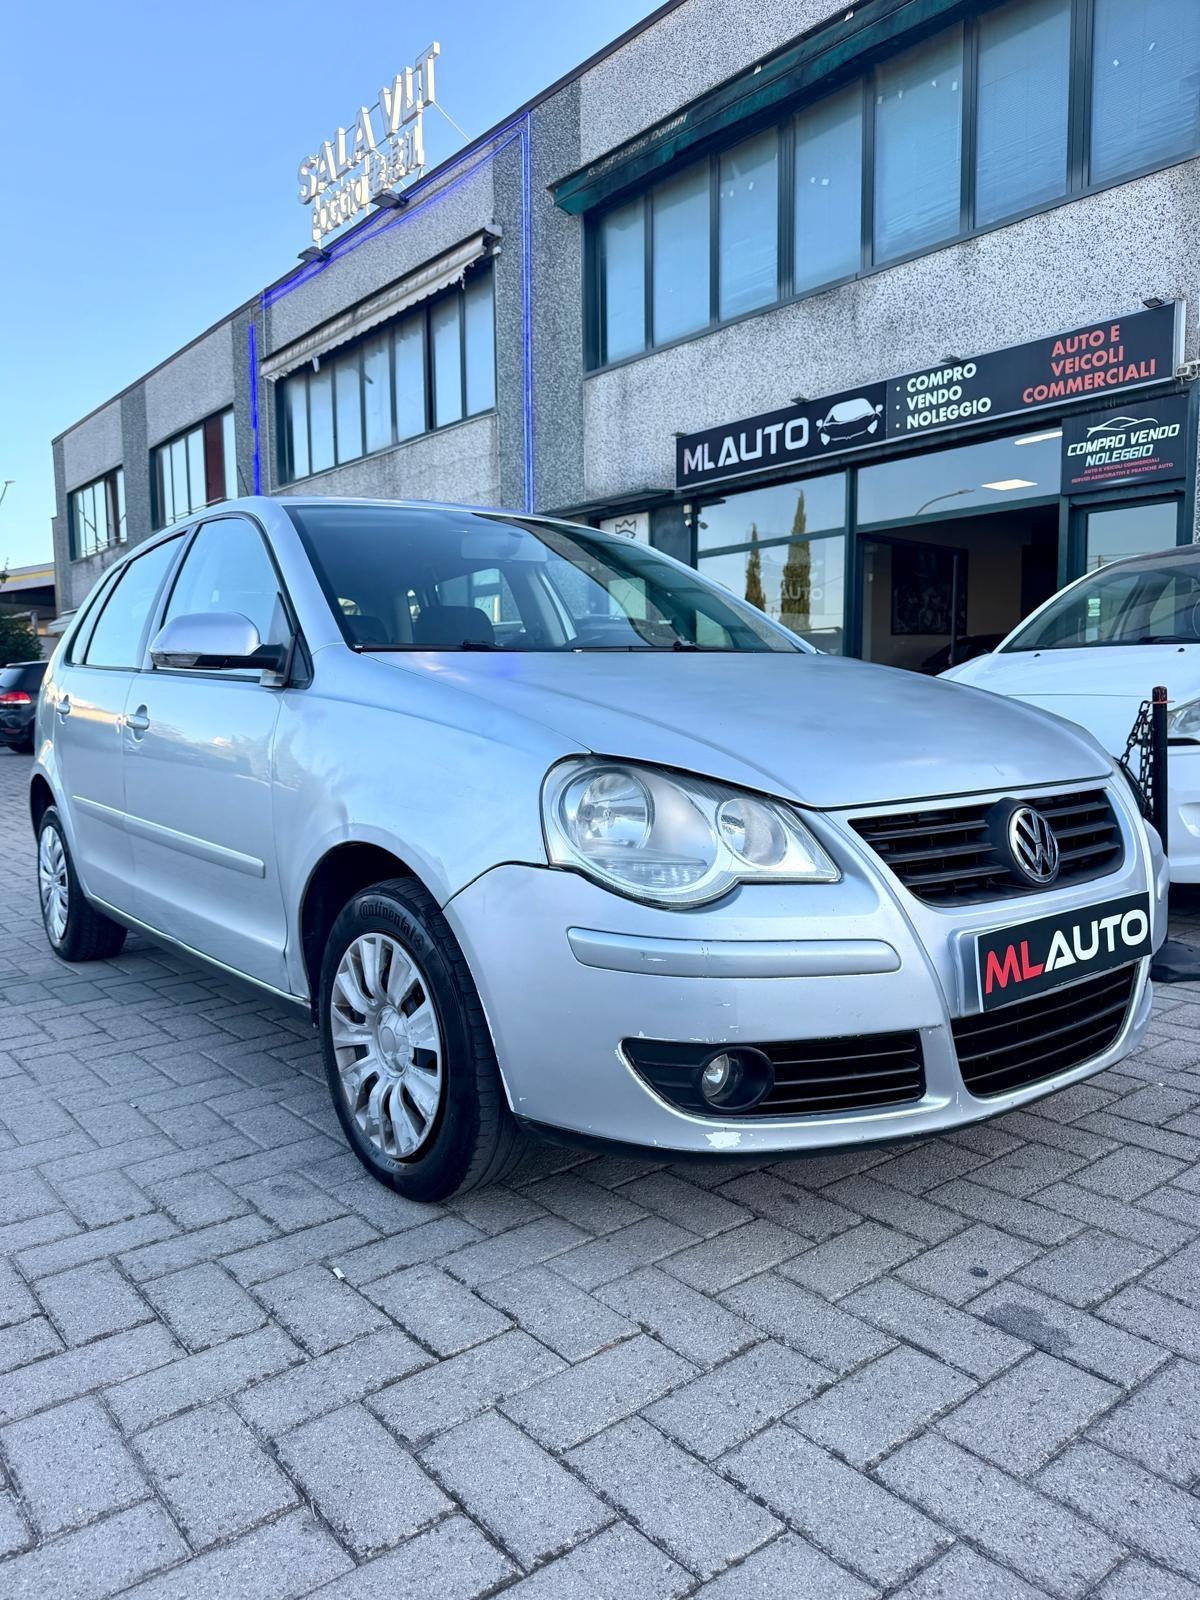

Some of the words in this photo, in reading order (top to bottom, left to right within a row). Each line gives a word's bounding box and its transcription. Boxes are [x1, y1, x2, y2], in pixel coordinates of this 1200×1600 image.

[298, 106, 377, 205] SALA
[1051, 329, 1105, 358] AUTO
[1110, 325, 1120, 343] E
[1051, 345, 1124, 377] VEICOLI
[906, 362, 977, 393] COMPRO
[1022, 358, 1156, 404] COMMERCIALI
[906, 385, 962, 411] VENDO
[906, 397, 992, 430] NOLEGGIO
[1067, 434, 1126, 457] COMPRO
[1130, 423, 1180, 444] VENDO
[1085, 444, 1154, 467] NOLEGGIO
[1084, 467, 1098, 475] AUTO
[1103, 463, 1123, 471] VEICOLI
[1158, 462, 1174, 470] AUTO
[360, 901, 418, 940] Continental
